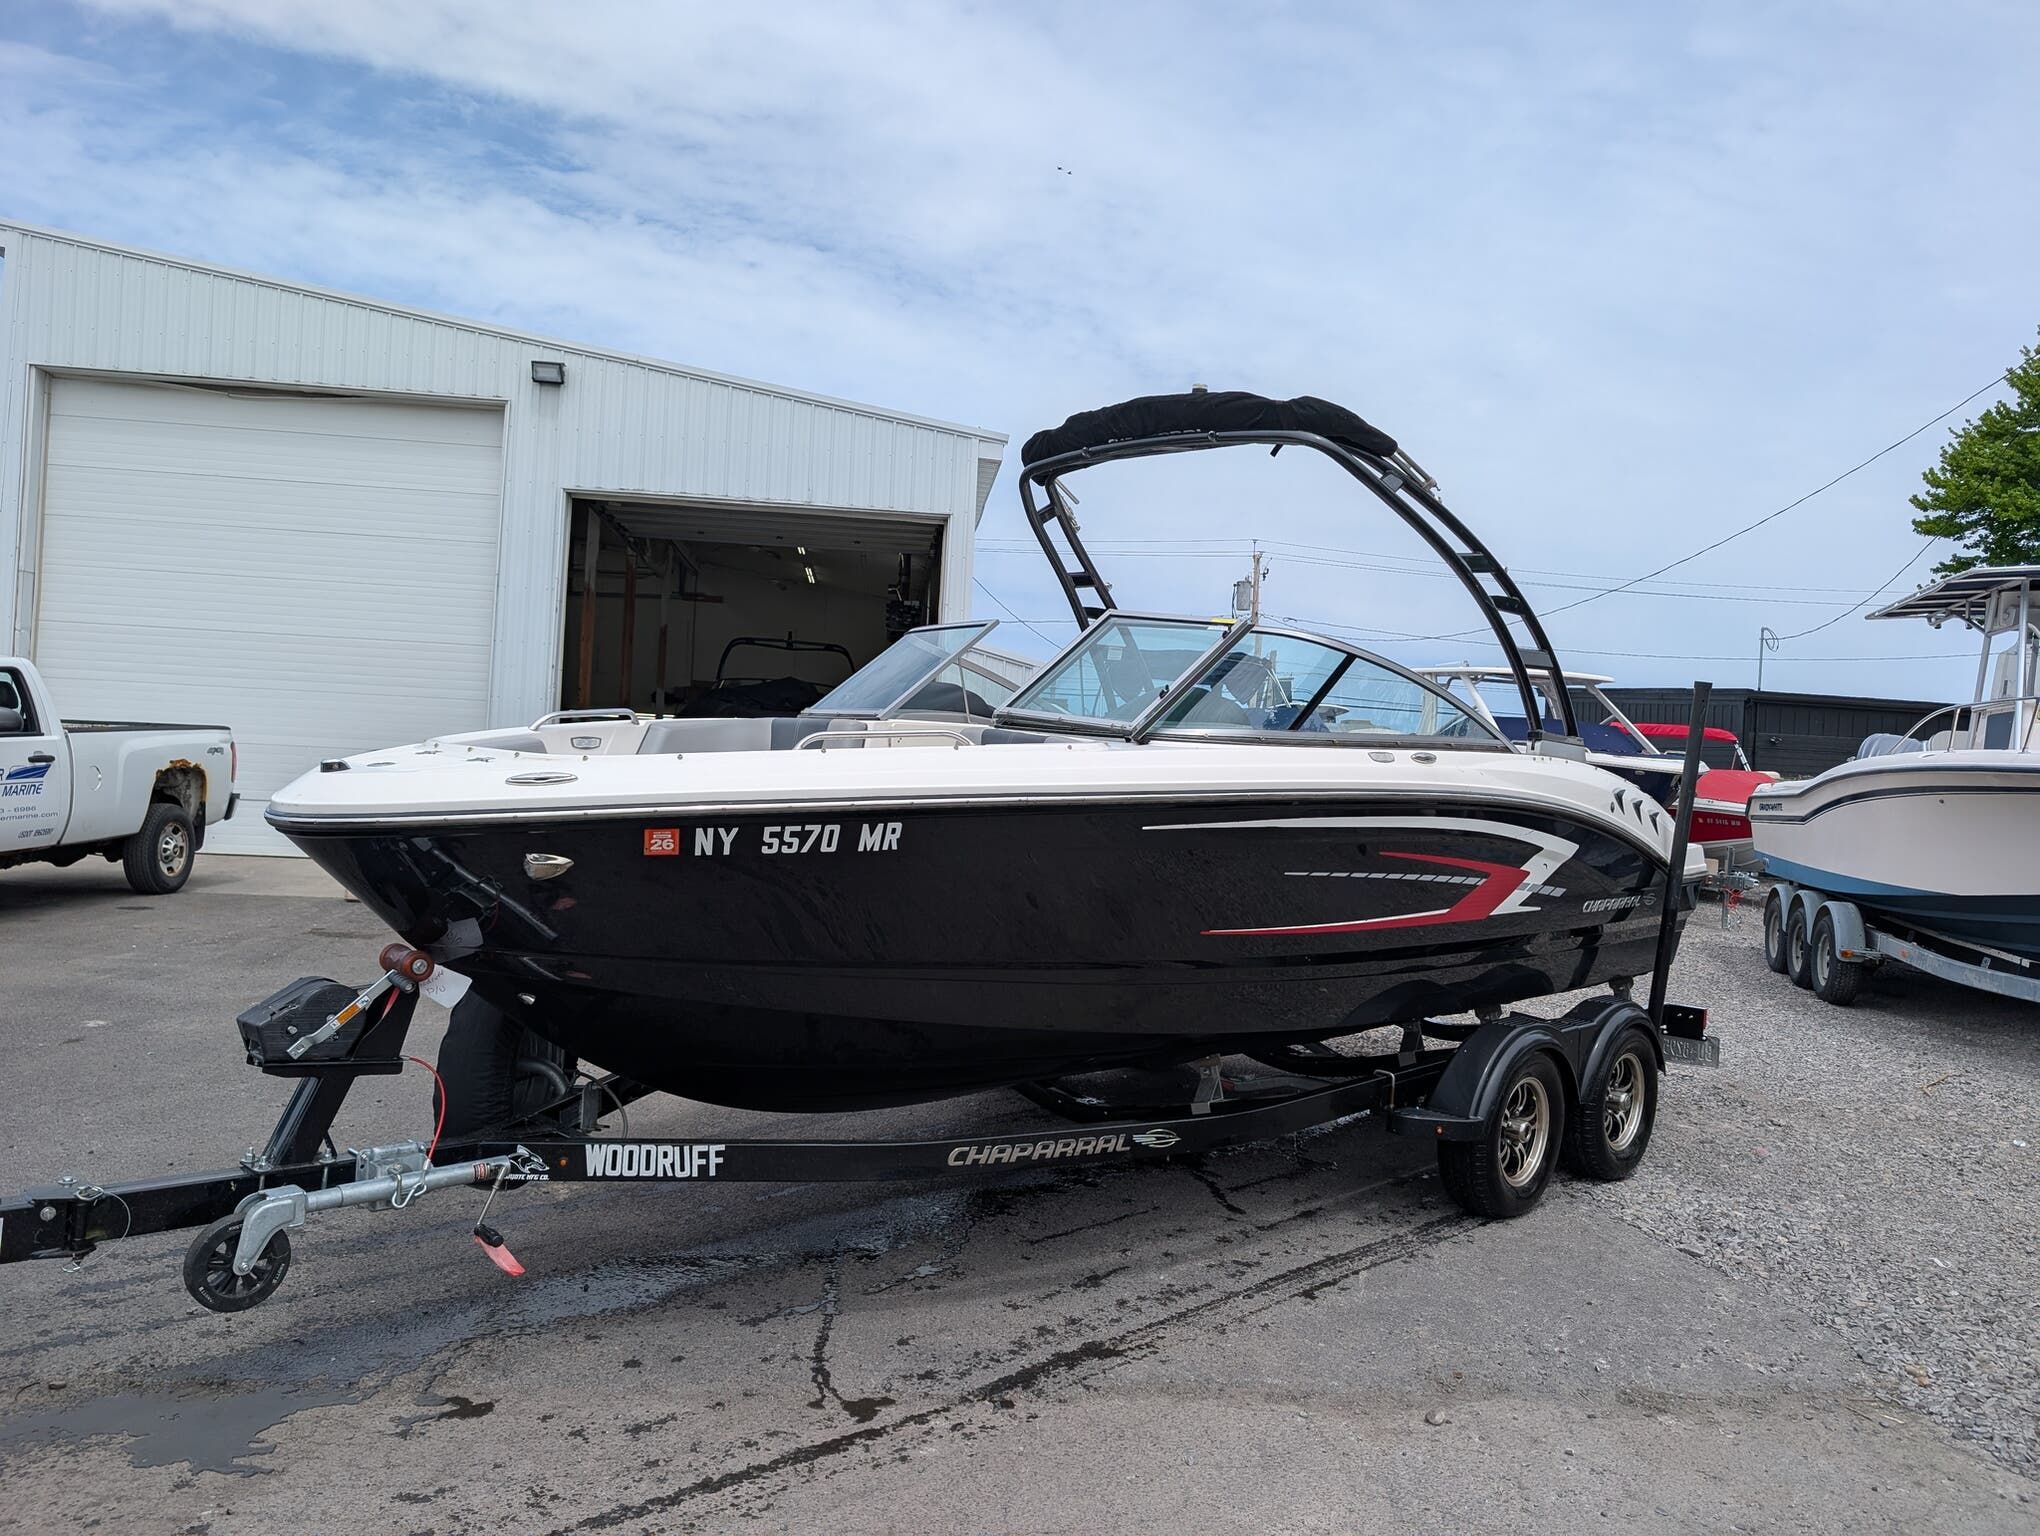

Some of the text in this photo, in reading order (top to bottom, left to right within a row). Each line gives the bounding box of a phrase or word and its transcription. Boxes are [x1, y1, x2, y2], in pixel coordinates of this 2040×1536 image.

[2, 783, 44, 797] MARINE
[650, 839, 675, 851] 26
[694, 822, 903, 856] NY 5570 MR
[585, 1144, 726, 1178] WOODRUFF
[947, 1133, 1132, 1167] CHAPARRAL
